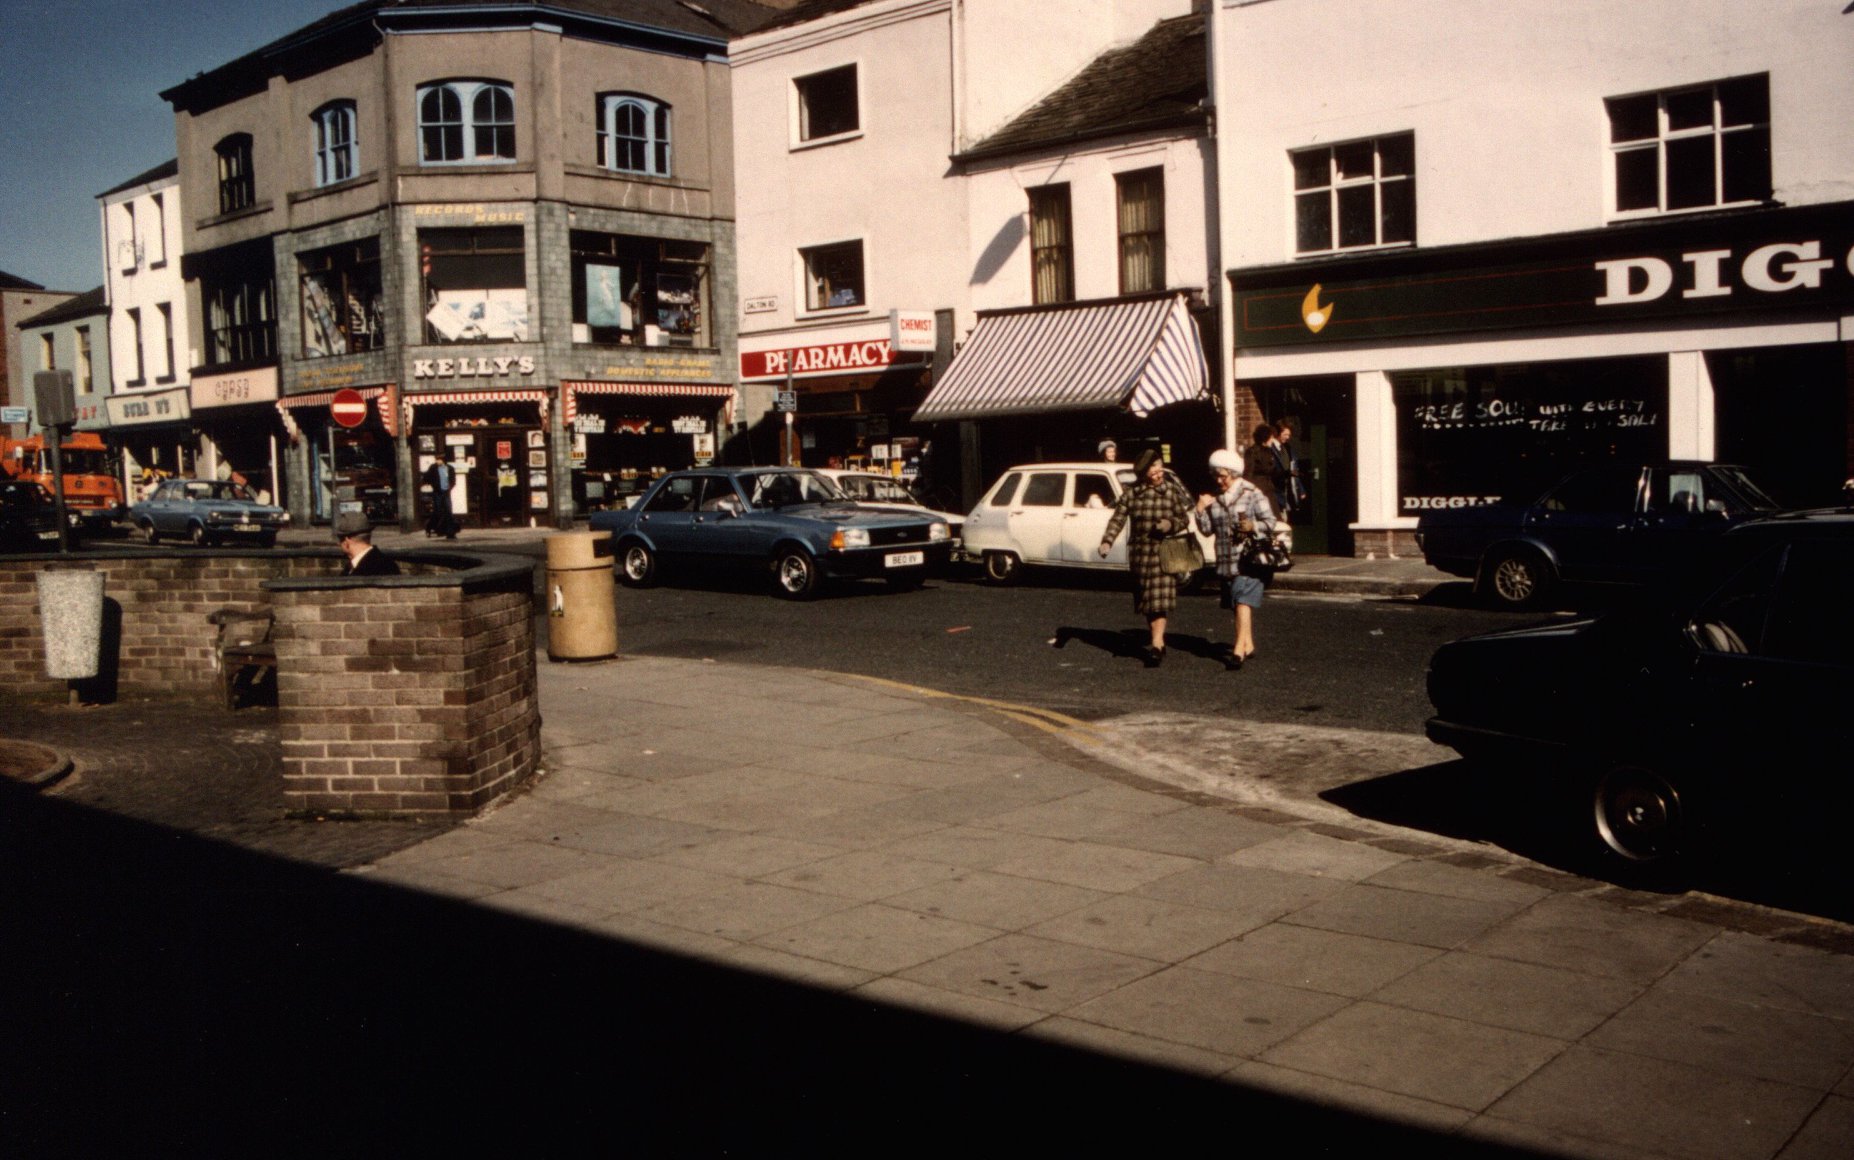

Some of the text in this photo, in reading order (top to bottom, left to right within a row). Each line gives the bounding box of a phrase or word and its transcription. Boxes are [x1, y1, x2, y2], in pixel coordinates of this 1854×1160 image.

[475, 212, 524, 222] MUSIC
[1595, 240, 1854, 305] DIG
[747, 301, 766, 310] DALTON
[900, 318, 932, 331] CHEMIST
[765, 341, 891, 373] PHARMACY
[414, 356, 535, 378] KELLY'S
[606, 366, 655, 376] DOMESTIC
[1474, 400, 1523, 418] SOU
